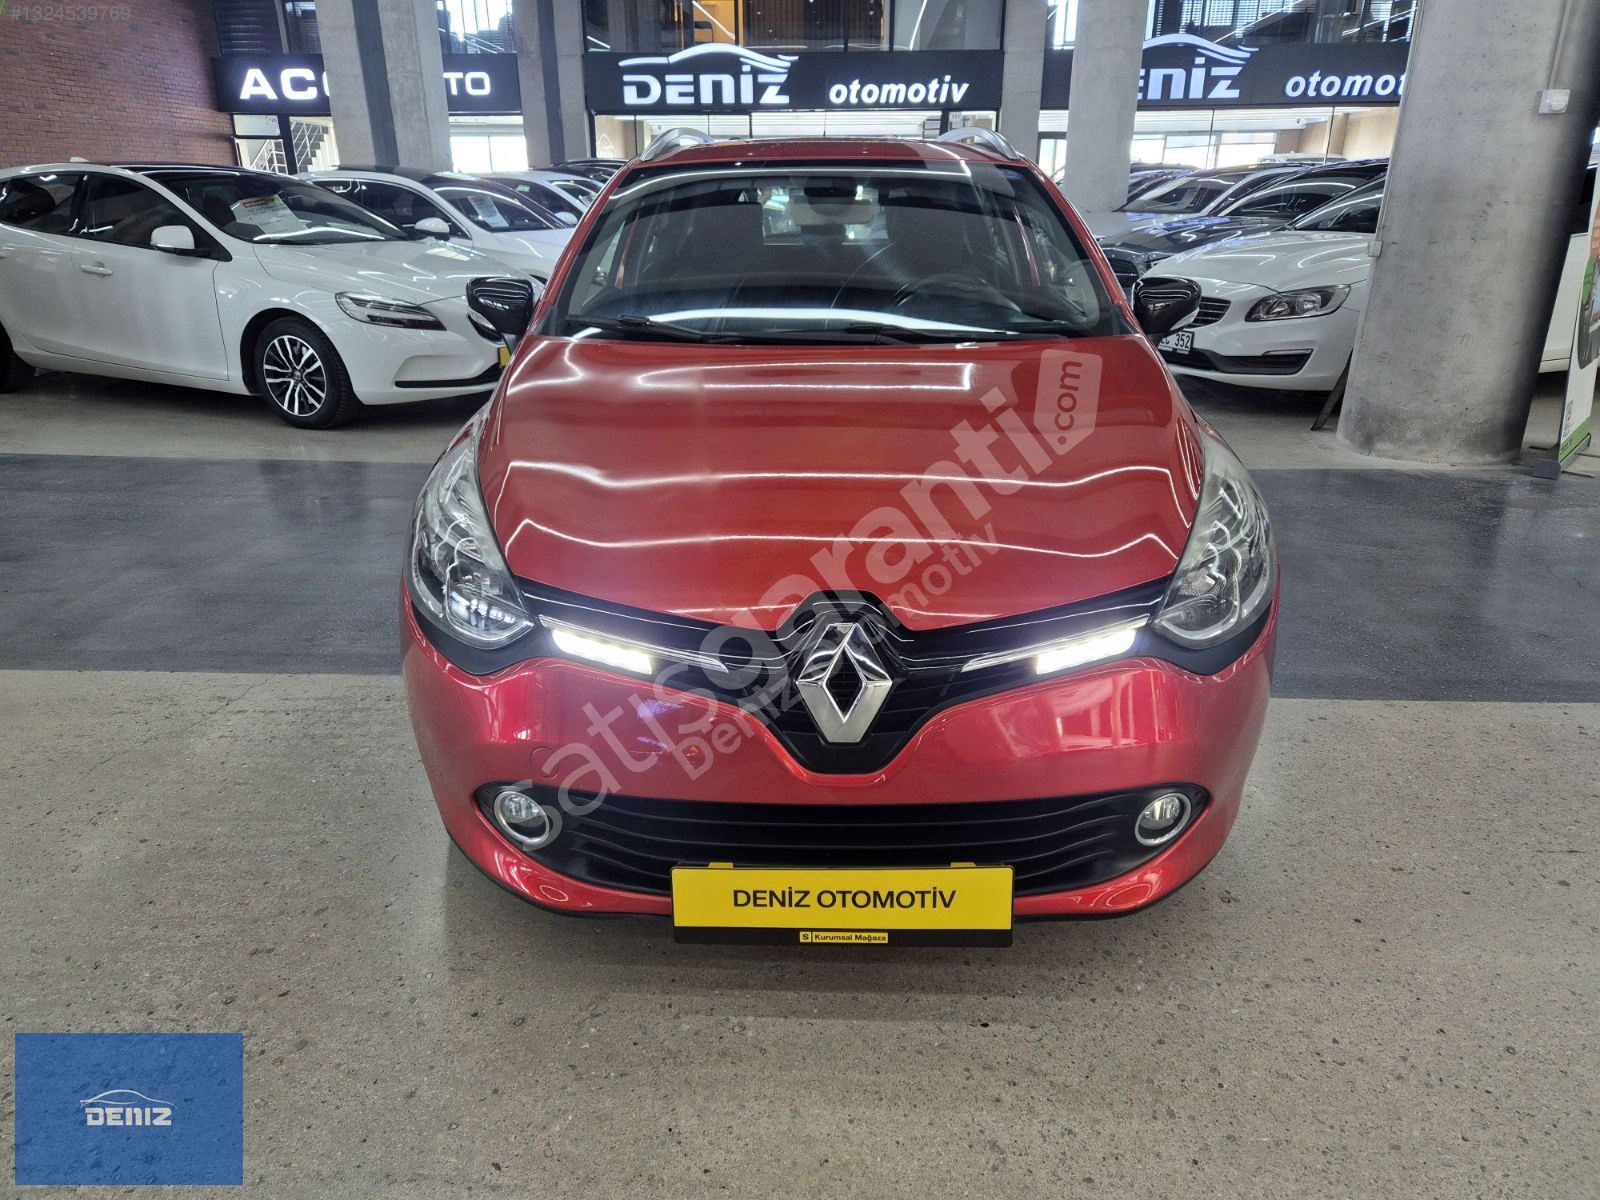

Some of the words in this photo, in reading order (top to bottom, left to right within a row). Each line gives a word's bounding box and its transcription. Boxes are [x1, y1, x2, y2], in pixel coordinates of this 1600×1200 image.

[239, 69, 329, 100] AC
[442, 72, 491, 96] TO
[828, 75, 970, 104] otomotiv
[1137, 57, 1243, 100] NİZ
[1174, 333, 1191, 349] 352
[733, 886, 811, 908] DENİZ
[817, 886, 957, 909] OTOMOTİV
[814, 933, 853, 941] Kurumsal
[855, 934, 887, 942] Mağaza
